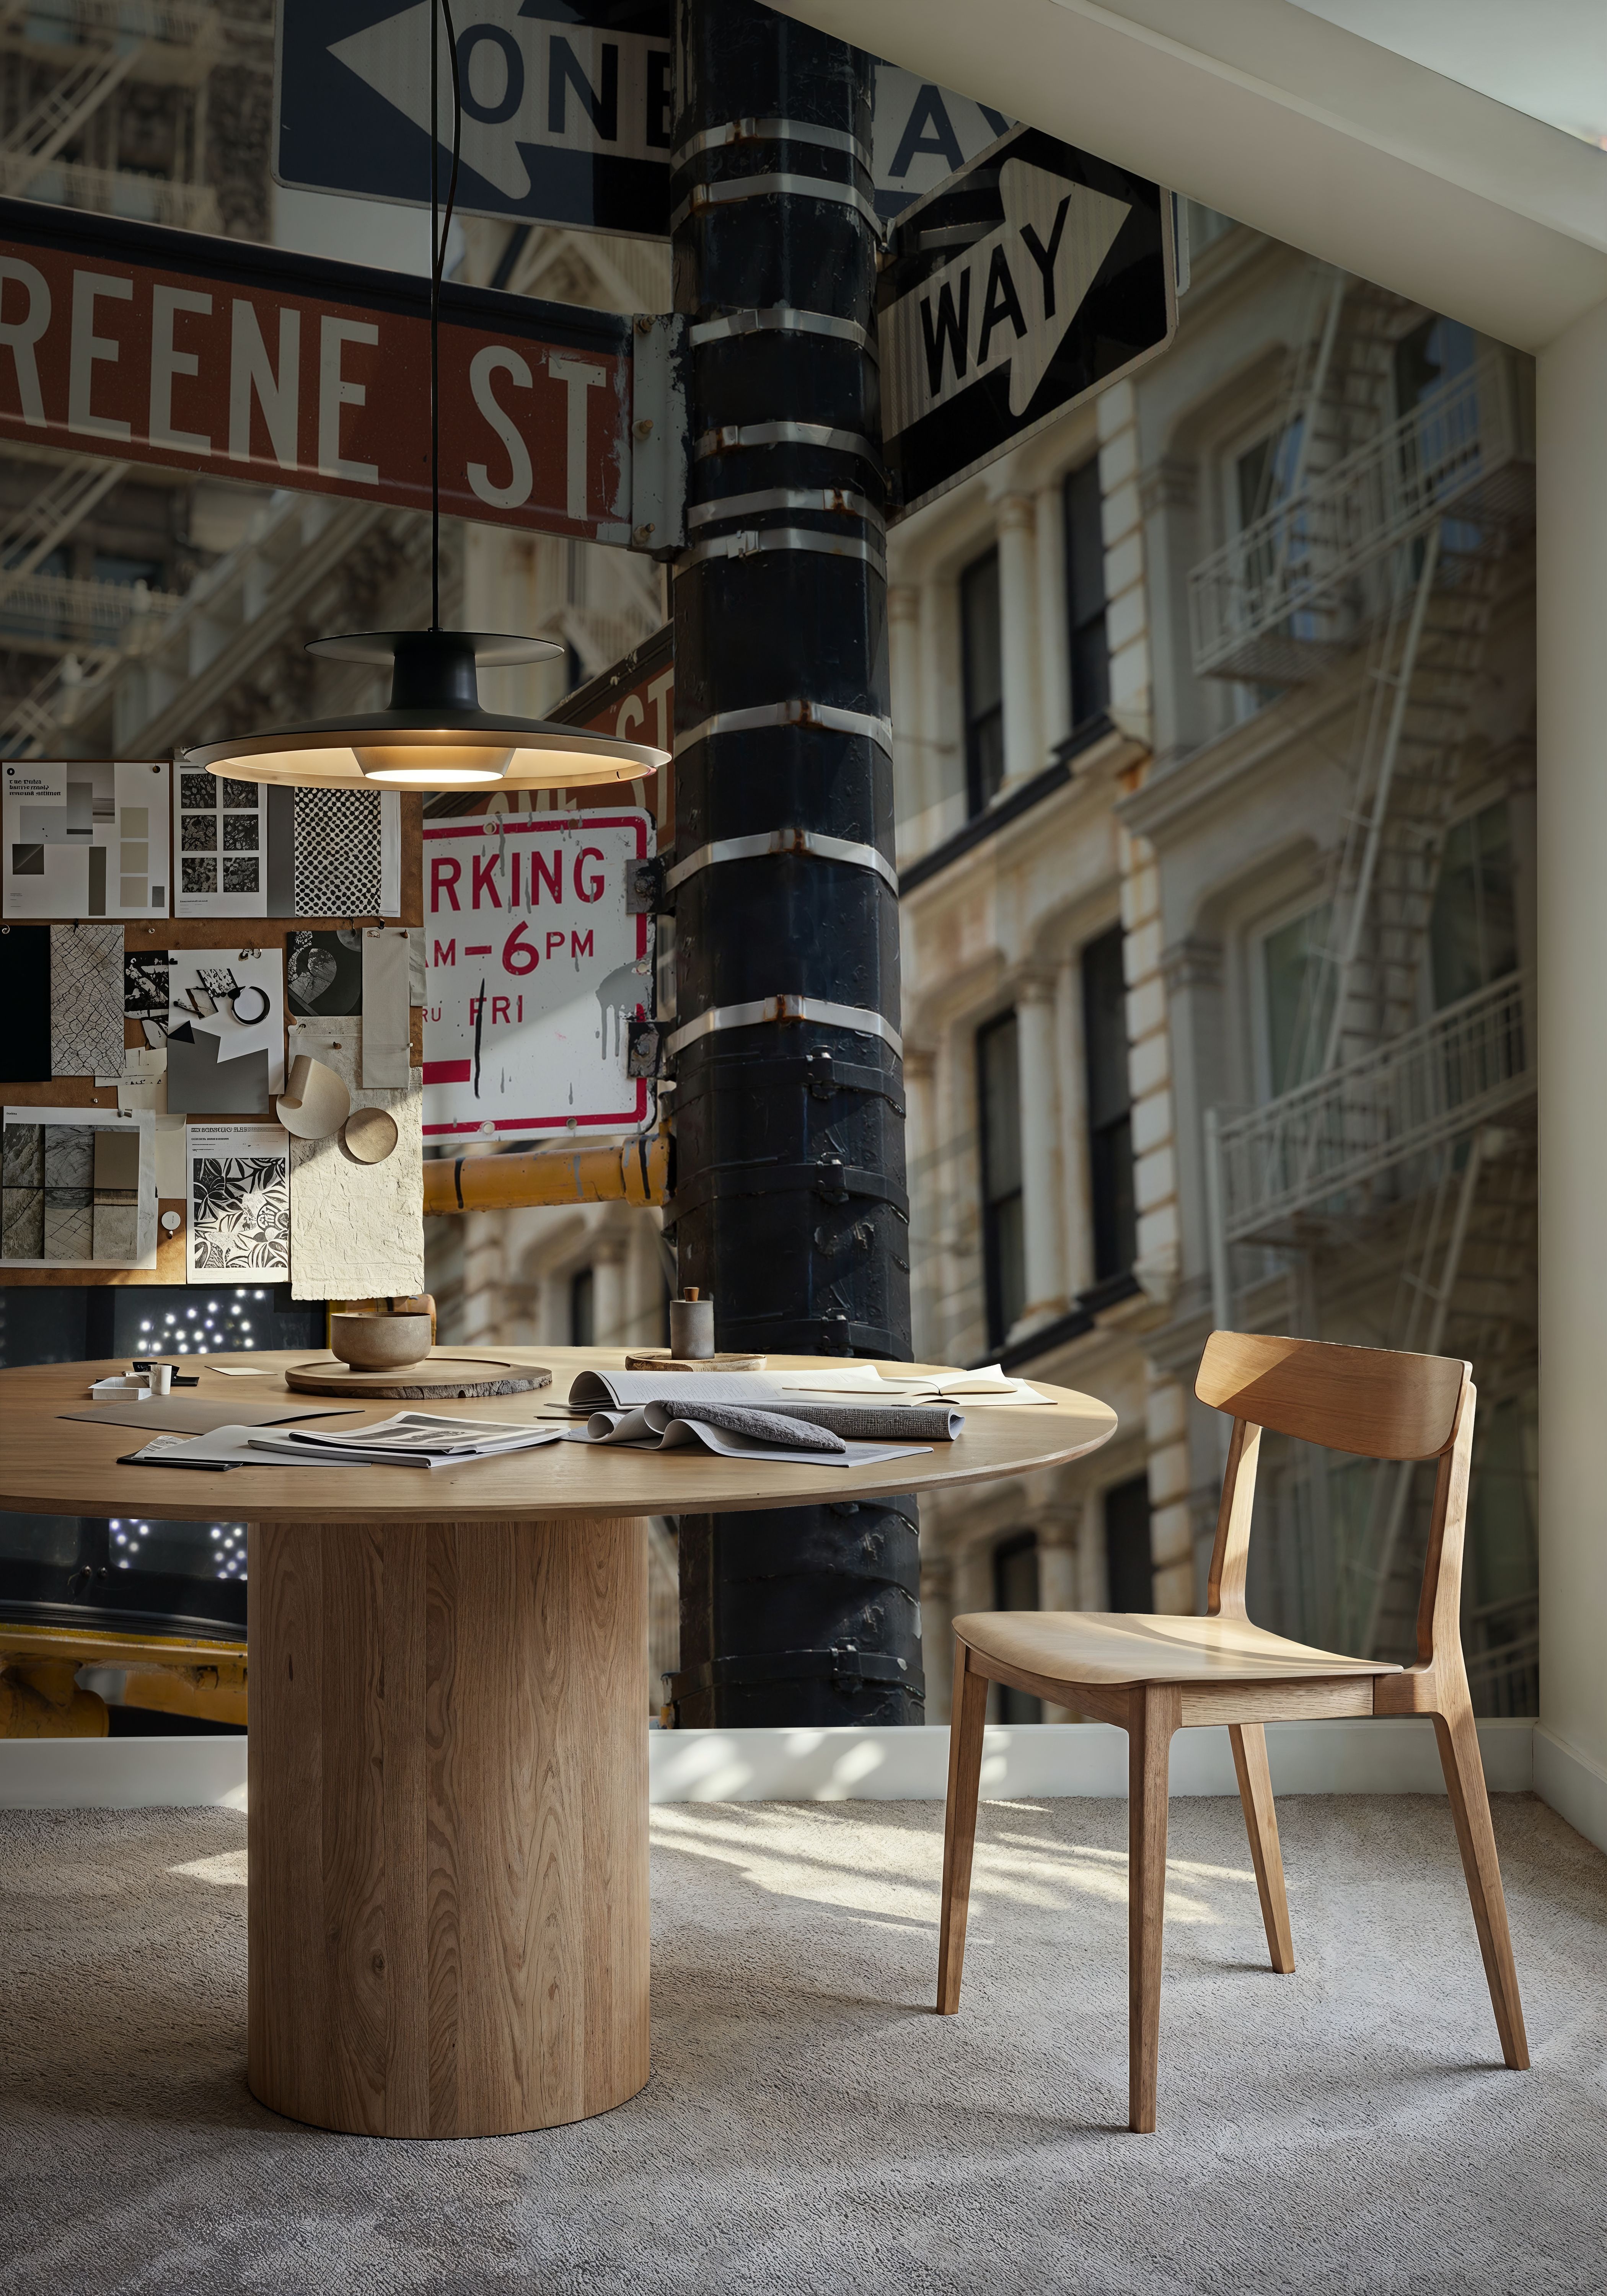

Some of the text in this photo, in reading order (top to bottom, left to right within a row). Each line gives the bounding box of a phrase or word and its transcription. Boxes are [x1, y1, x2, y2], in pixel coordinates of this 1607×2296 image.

[920, 194, 1071, 398] WAY
[0, 255, 606, 522] REENE ST
[431, 847, 605, 913] RKING
[470, 995, 523, 1026] FRI
